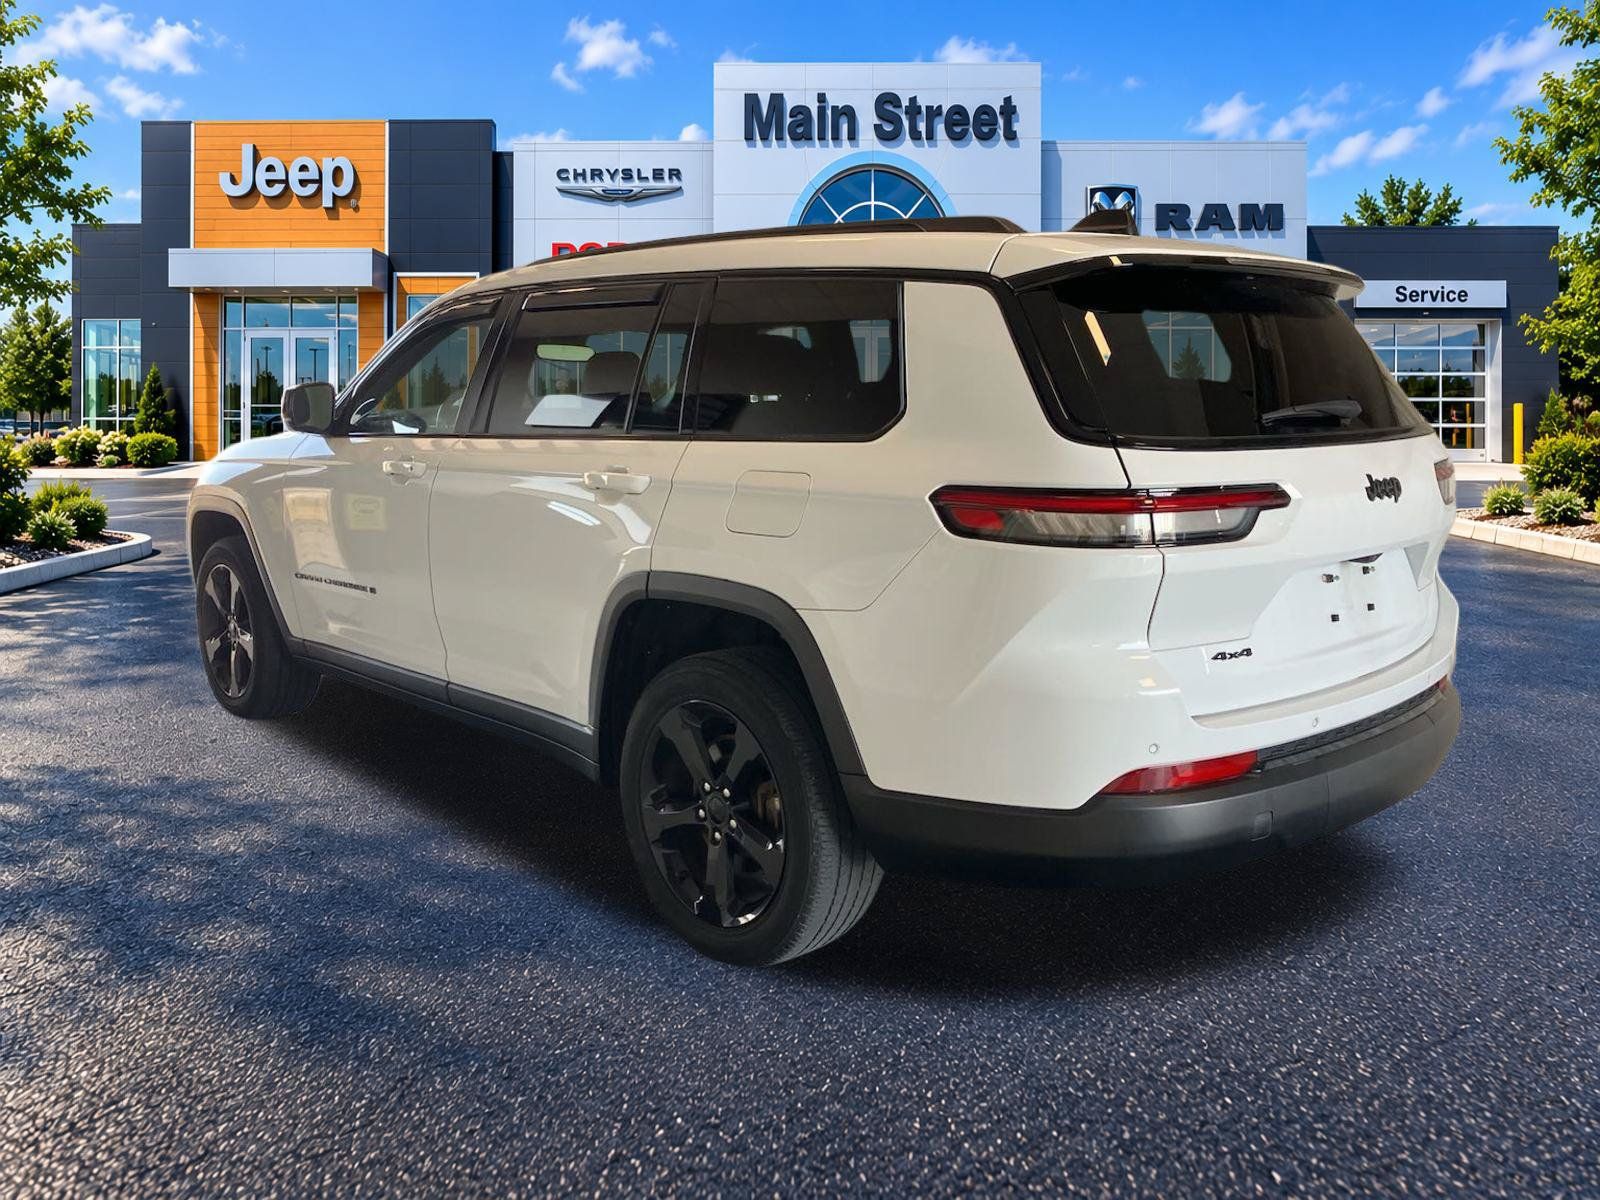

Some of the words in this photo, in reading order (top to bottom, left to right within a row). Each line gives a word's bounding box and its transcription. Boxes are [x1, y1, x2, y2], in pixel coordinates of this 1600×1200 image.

[743, 92, 857, 141] Main
[873, 91, 1017, 141] Street
[219, 143, 355, 208] Jeep
[556, 167, 683, 184] CHRYSLER
[1155, 203, 1284, 231] RAM
[1395, 285, 1469, 303] Service
[1365, 473, 1402, 503] Jeep
[1211, 647, 1253, 661] 4x4
